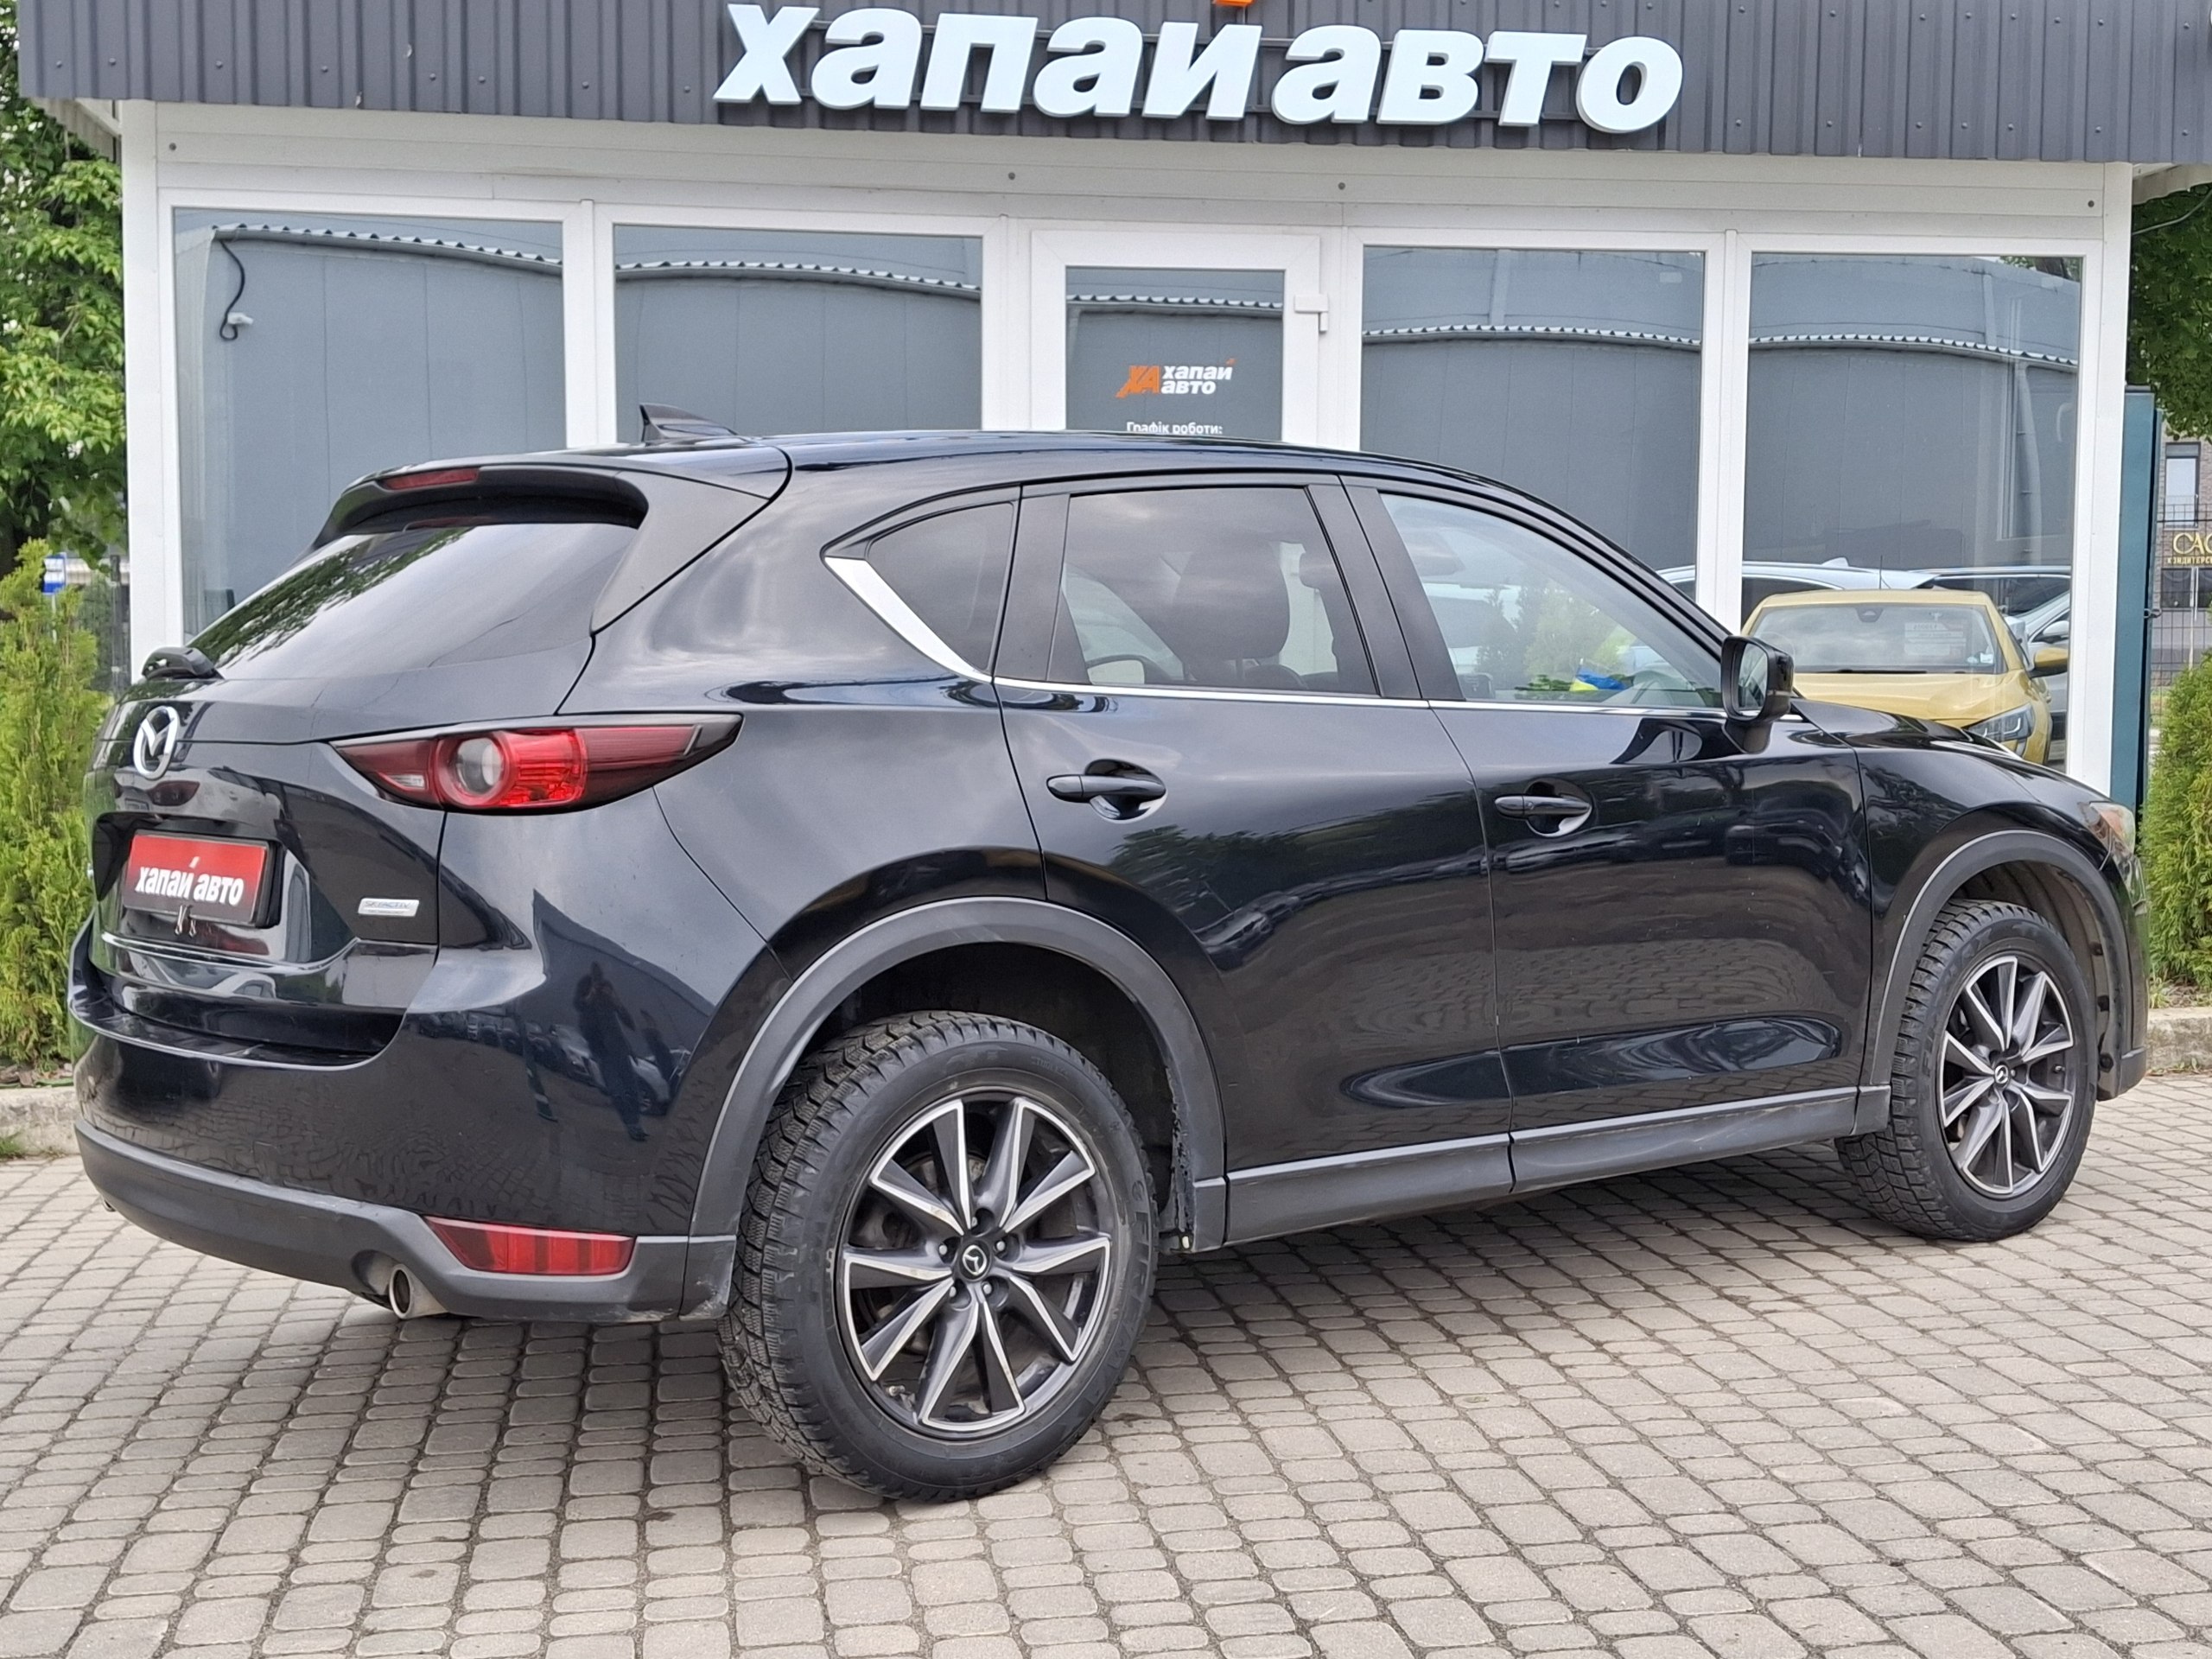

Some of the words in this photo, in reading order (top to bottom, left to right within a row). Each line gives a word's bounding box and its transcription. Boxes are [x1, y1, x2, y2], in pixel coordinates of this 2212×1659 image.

[1271, 24, 1683, 133] авто
[1162, 359, 1236, 380] хапай
[1160, 380, 1217, 394] авто
[1172, 423, 1224, 434] роботи:
[135, 856, 200, 899] хапай
[193, 874, 244, 906] авто
